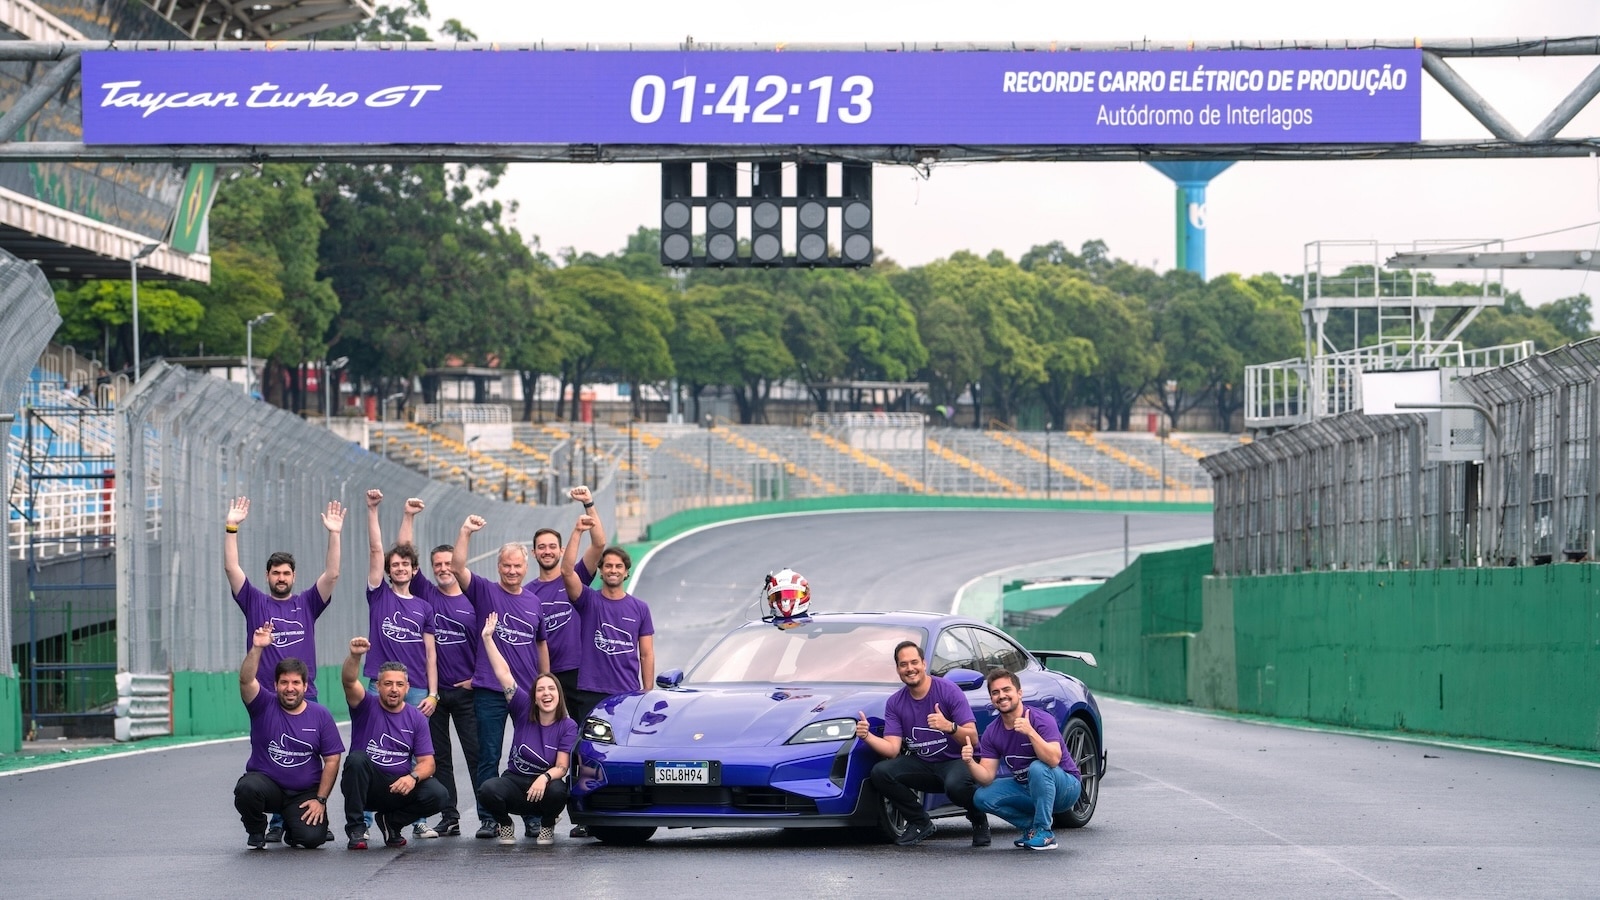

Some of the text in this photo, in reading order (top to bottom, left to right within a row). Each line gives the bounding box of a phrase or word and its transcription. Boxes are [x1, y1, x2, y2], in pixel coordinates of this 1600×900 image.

[1003, 63, 1407, 97] RECORDE CARRO ELÉTRICO DE PRODUÇÃO
[100, 80, 443, 118] Taycan turbo GT
[630, 74, 874, 124] 01:42:13
[1096, 104, 1313, 131] Autódromo de Interlagos
[659, 768, 703, 781] SGL8H94
